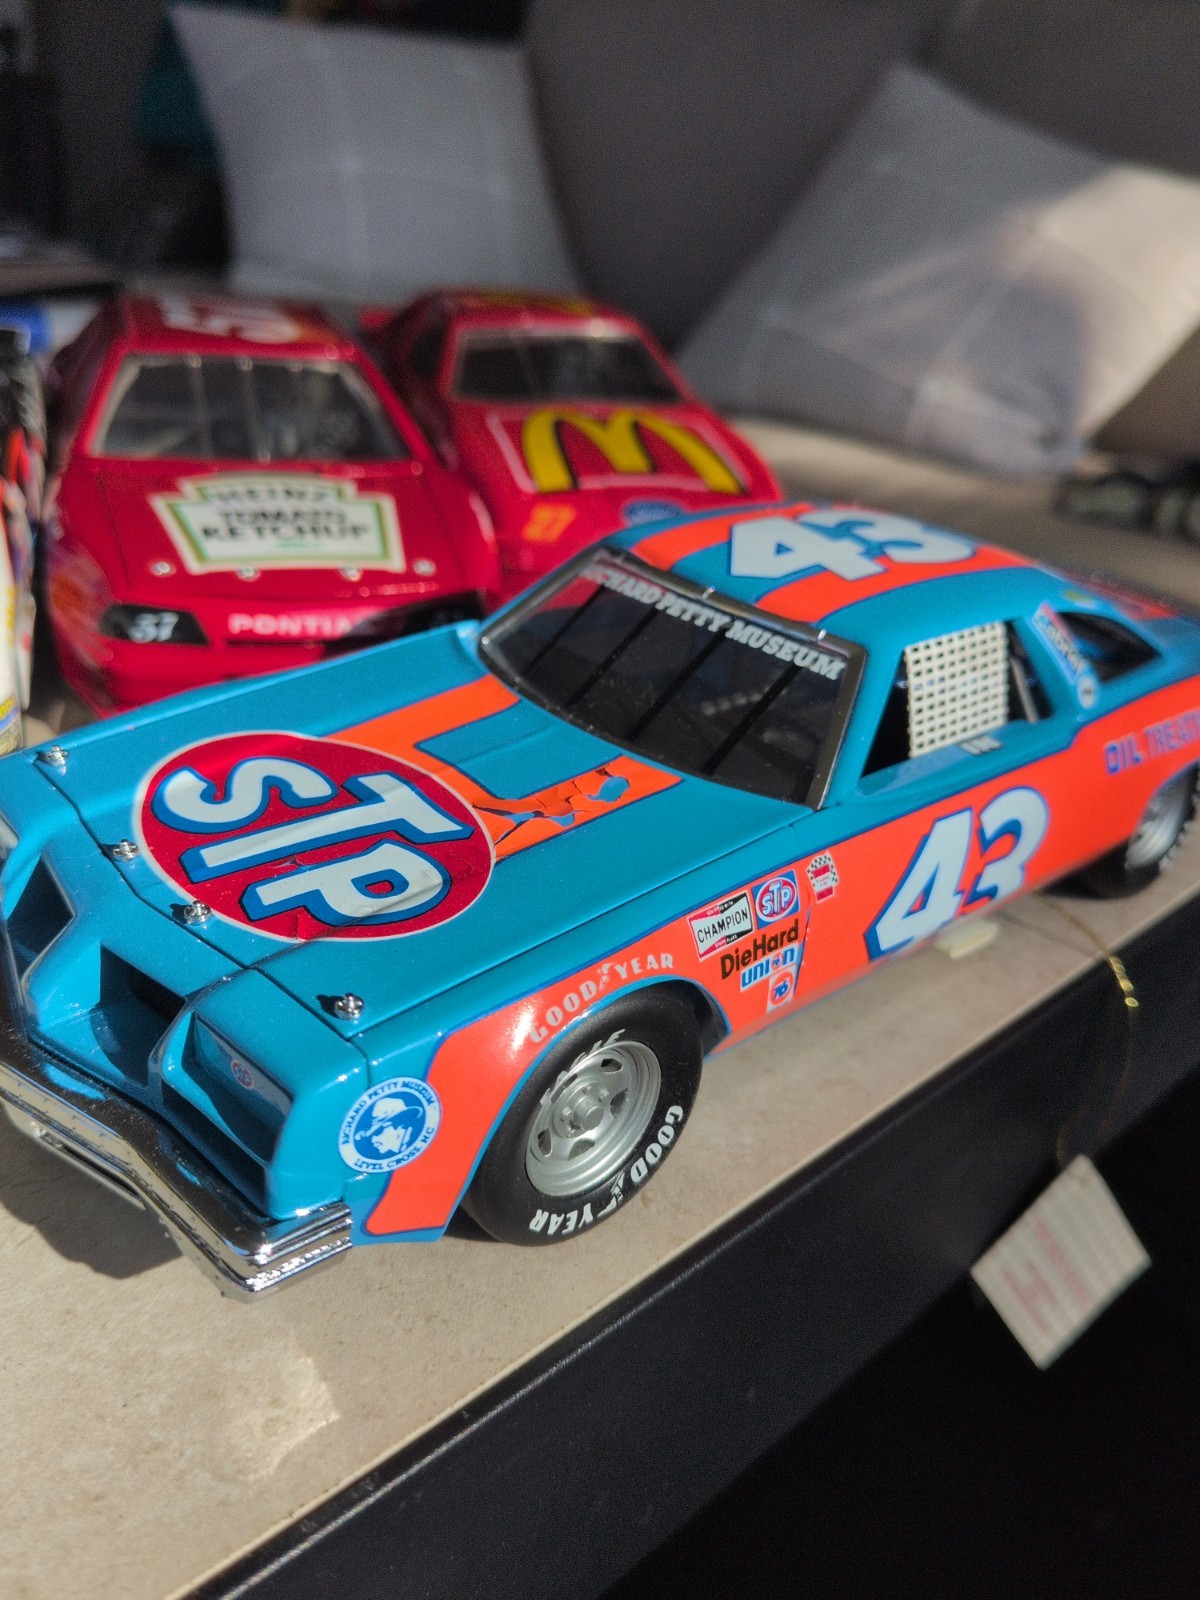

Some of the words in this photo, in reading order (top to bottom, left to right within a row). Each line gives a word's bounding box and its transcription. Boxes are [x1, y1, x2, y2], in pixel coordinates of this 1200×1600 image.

[730, 509, 977, 581] 43
[655, 593, 731, 633] PETTY
[725, 618, 847, 681] MUSEUM
[1104, 734, 1144, 775] OIL
[151, 757, 475, 926] STP
[864, 785, 1051, 962] 43
[697, 907, 748, 943] CHAMPION
[761, 879, 793, 916] STP
[720, 918, 799, 980] DieHard
